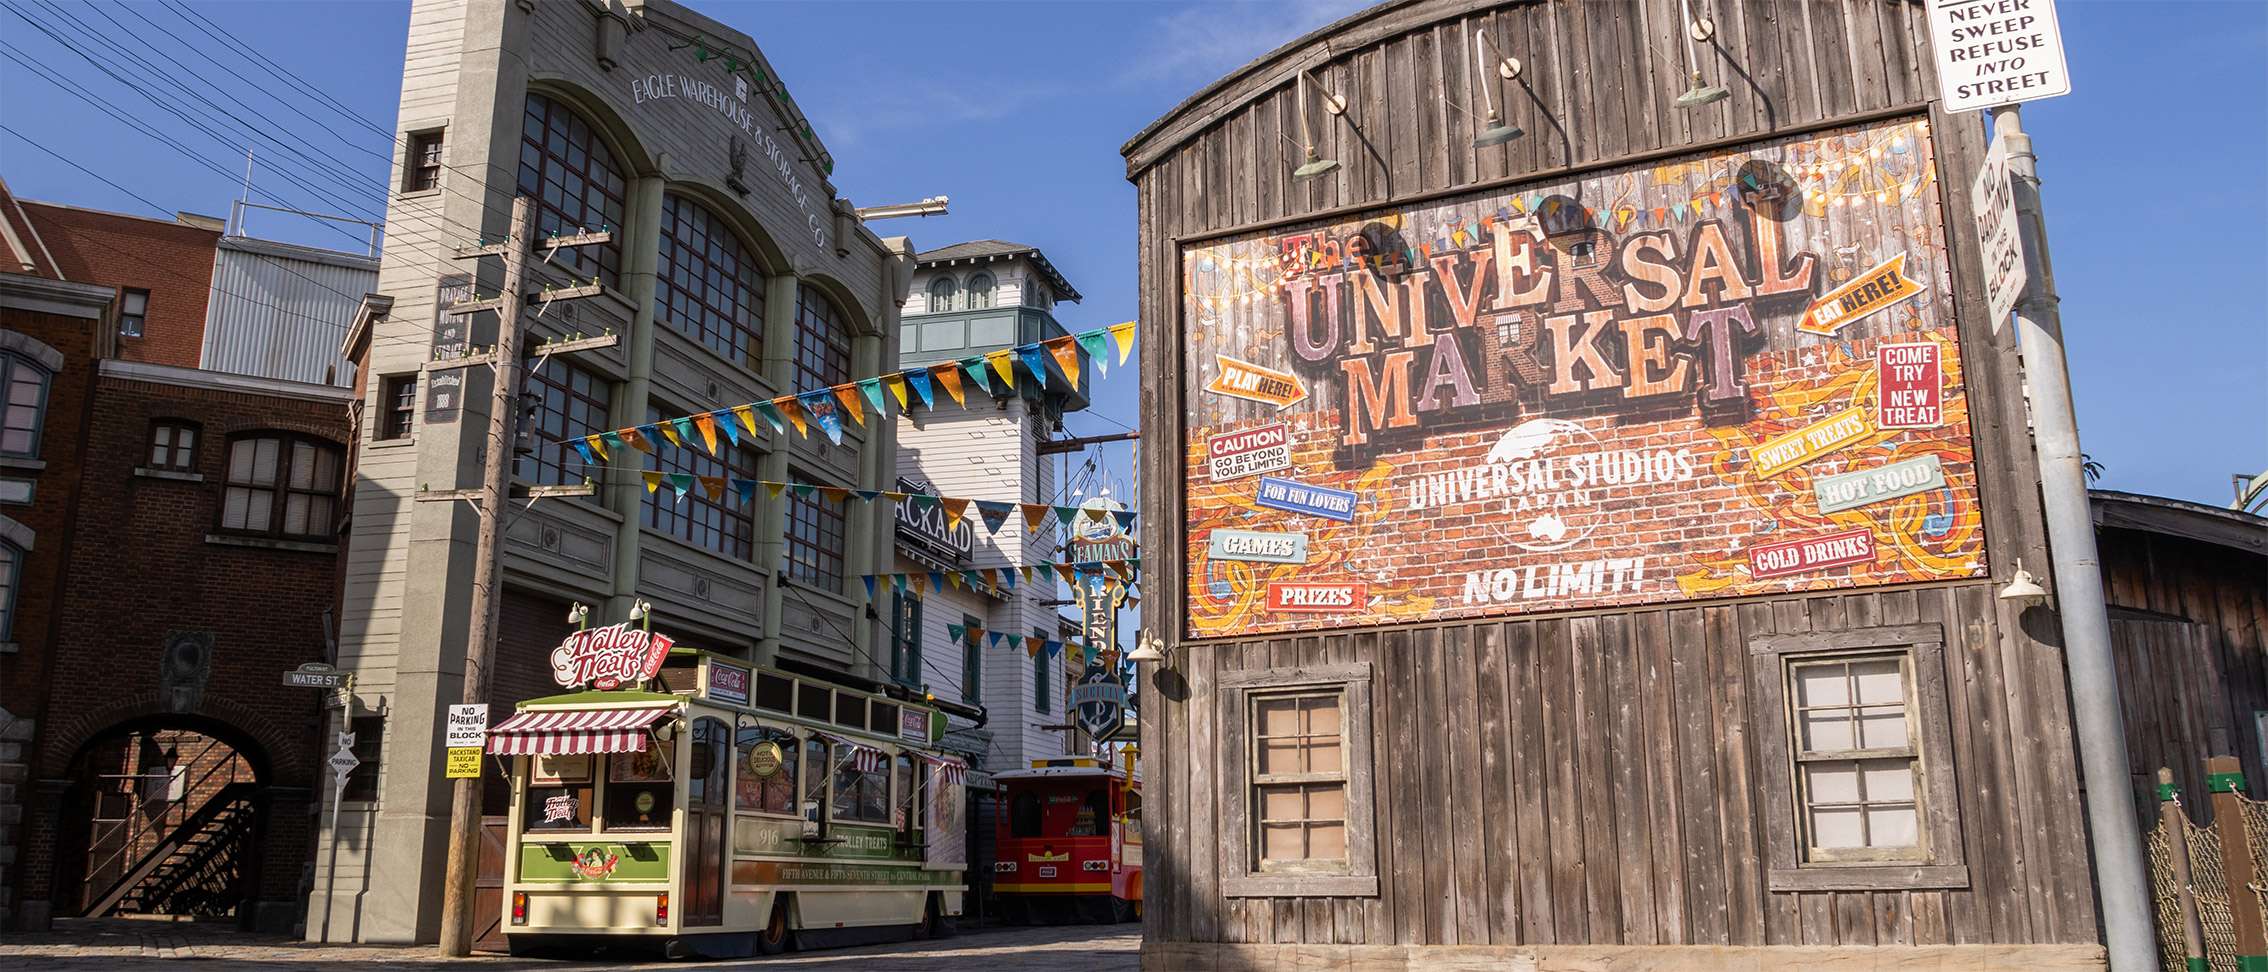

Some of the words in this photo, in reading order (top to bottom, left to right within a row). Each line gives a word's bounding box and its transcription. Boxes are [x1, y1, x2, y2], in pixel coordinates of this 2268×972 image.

[1950, 0, 2030, 23] NEVER
[1951, 15, 2035, 42] SWEEP
[1950, 33, 2045, 62] REFUSE
[1976, 57, 2025, 76] INTO
[1957, 71, 2050, 99] STREET
[632, 74, 676, 104] EAGLE
[679, 75, 754, 137] WAREHOUSE
[754, 126, 763, 147] &
[765, 135, 809, 216] STORAGE
[808, 213, 825, 254] CO.
[1983, 162, 1996, 206] NO
[1978, 160, 2010, 253] PARKING
[1282, 232, 1370, 273] The
[1284, 191, 1814, 361] UNIVERSAL
[1989, 237, 2018, 303] BLOCK
[444, 328, 456, 340] AND
[1886, 347, 1933, 365] COME
[1339, 303, 1756, 446] MARKET
[1893, 365, 1925, 382] TRY
[1891, 389, 1928, 406] NEW
[1884, 407, 1936, 424] TREAT
[1213, 429, 1283, 455] CAUTION
[1758, 436, 1808, 471] SWEET
[1807, 414, 1865, 451] TREATS
[1215, 458, 1232, 468] GO
[1236, 447, 1284, 465] BEYOND
[1215, 465, 1245, 478] YOUR
[1249, 456, 1287, 471] LIMITS!
[1409, 459, 1560, 509] UNIVERSAL
[1569, 449, 1693, 487] STUDIOS
[1823, 477, 1868, 505] HOT
[1872, 464, 1932, 493] FOOD
[1263, 484, 1286, 500] FOR
[1288, 490, 1309, 505] FUN
[1309, 493, 1350, 513] LOVERS
[1502, 490, 1591, 513] JAPAN
[895, 485, 971, 552] ACKARD
[1223, 535, 1294, 557] GAMES
[1756, 547, 1799, 571] COLD
[1804, 535, 1868, 564] DRINKS
[1462, 568, 1517, 605] NO
[1522, 558, 1645, 599] LIMIT!
[1280, 587, 1353, 606] PRIZES
[1089, 584, 1107, 666] RIENDS
[571, 624, 650, 659] Trolley
[292, 674, 323, 686] WATER
[324, 676, 340, 686] ST.
[568, 651, 640, 688] Treats
[450, 712, 485, 726] PARKING
[462, 707, 475, 715] NO
[342, 738, 352, 746] NO
[759, 829, 778, 846] 916
[836, 834, 864, 849] TROLLEY
[865, 836, 888, 850] TREATS
